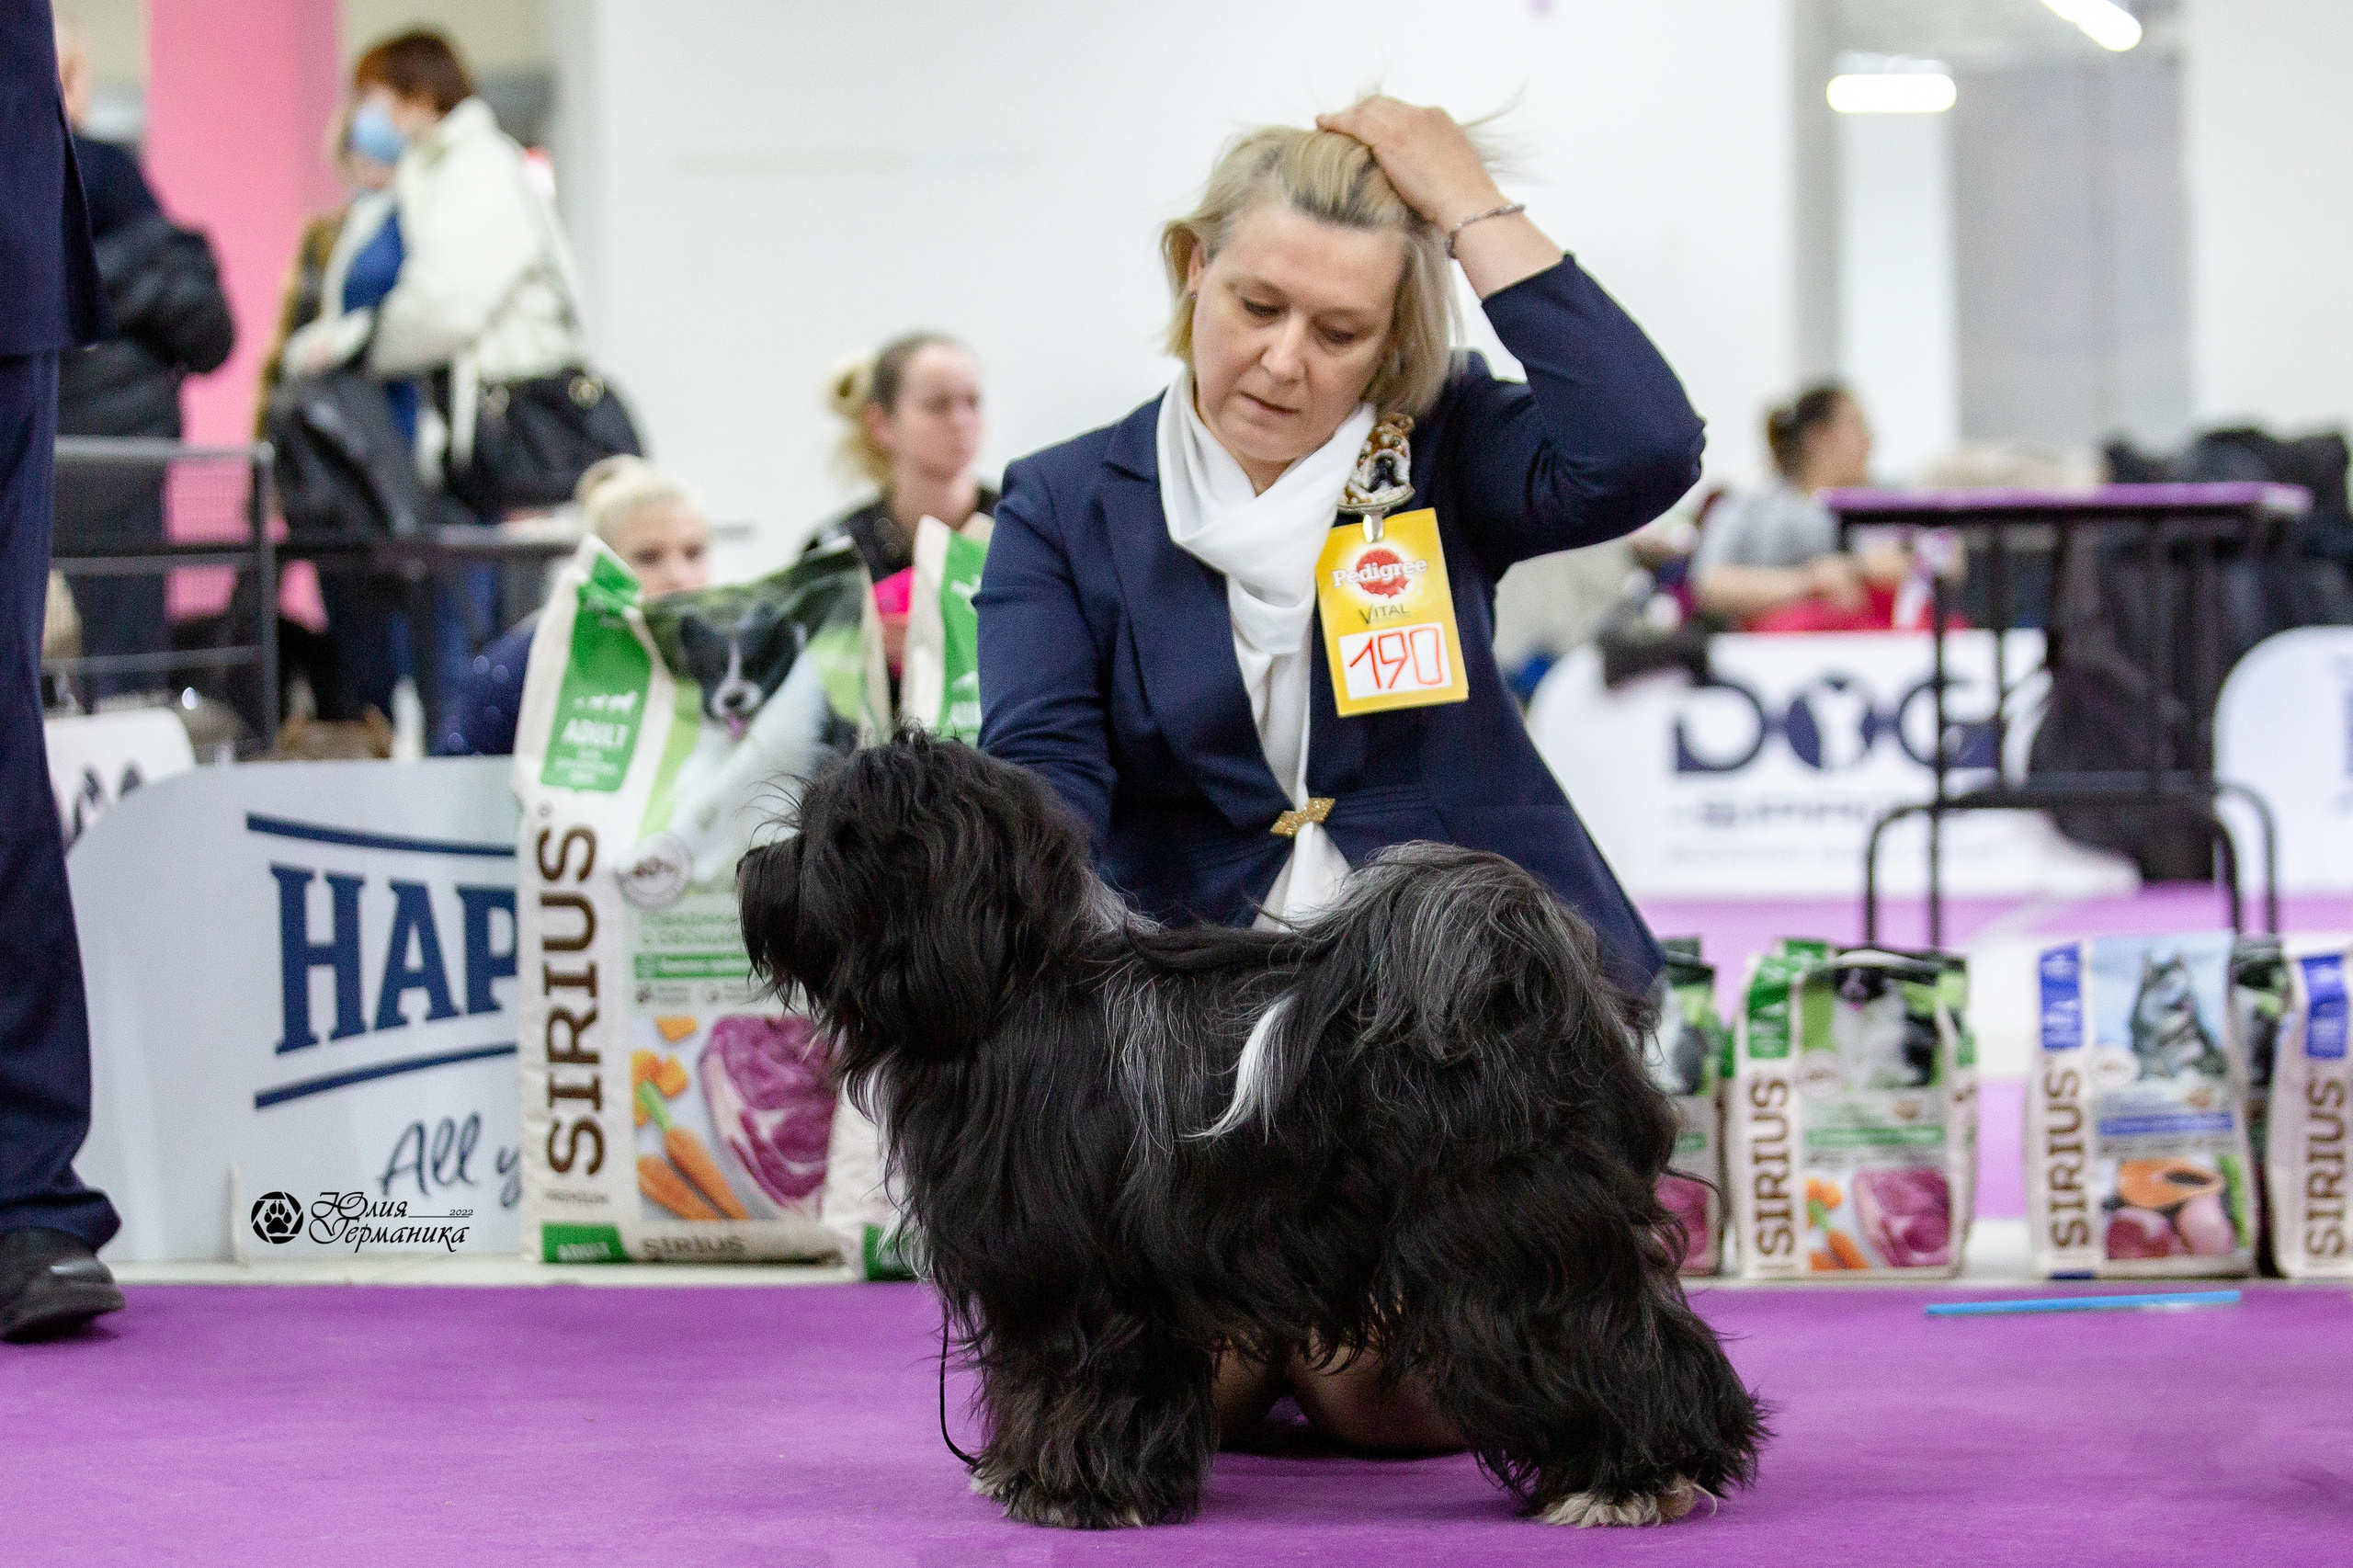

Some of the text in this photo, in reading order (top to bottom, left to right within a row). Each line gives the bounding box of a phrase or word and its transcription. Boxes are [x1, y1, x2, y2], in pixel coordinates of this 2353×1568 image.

[1332, 557, 1428, 588] Pedigree
[1358, 602, 1410, 625] VITAL
[1349, 627, 1443, 689] 190
[561, 717, 630, 751] ADULT
[537, 825, 606, 1177] SIRIUS
[377, 1110, 482, 1199] All
[1749, 1076, 1795, 1257] SIRIUS
[2043, 1068, 2092, 1250] SIRIUS
[2305, 1077, 2347, 1258] SIRIUS
